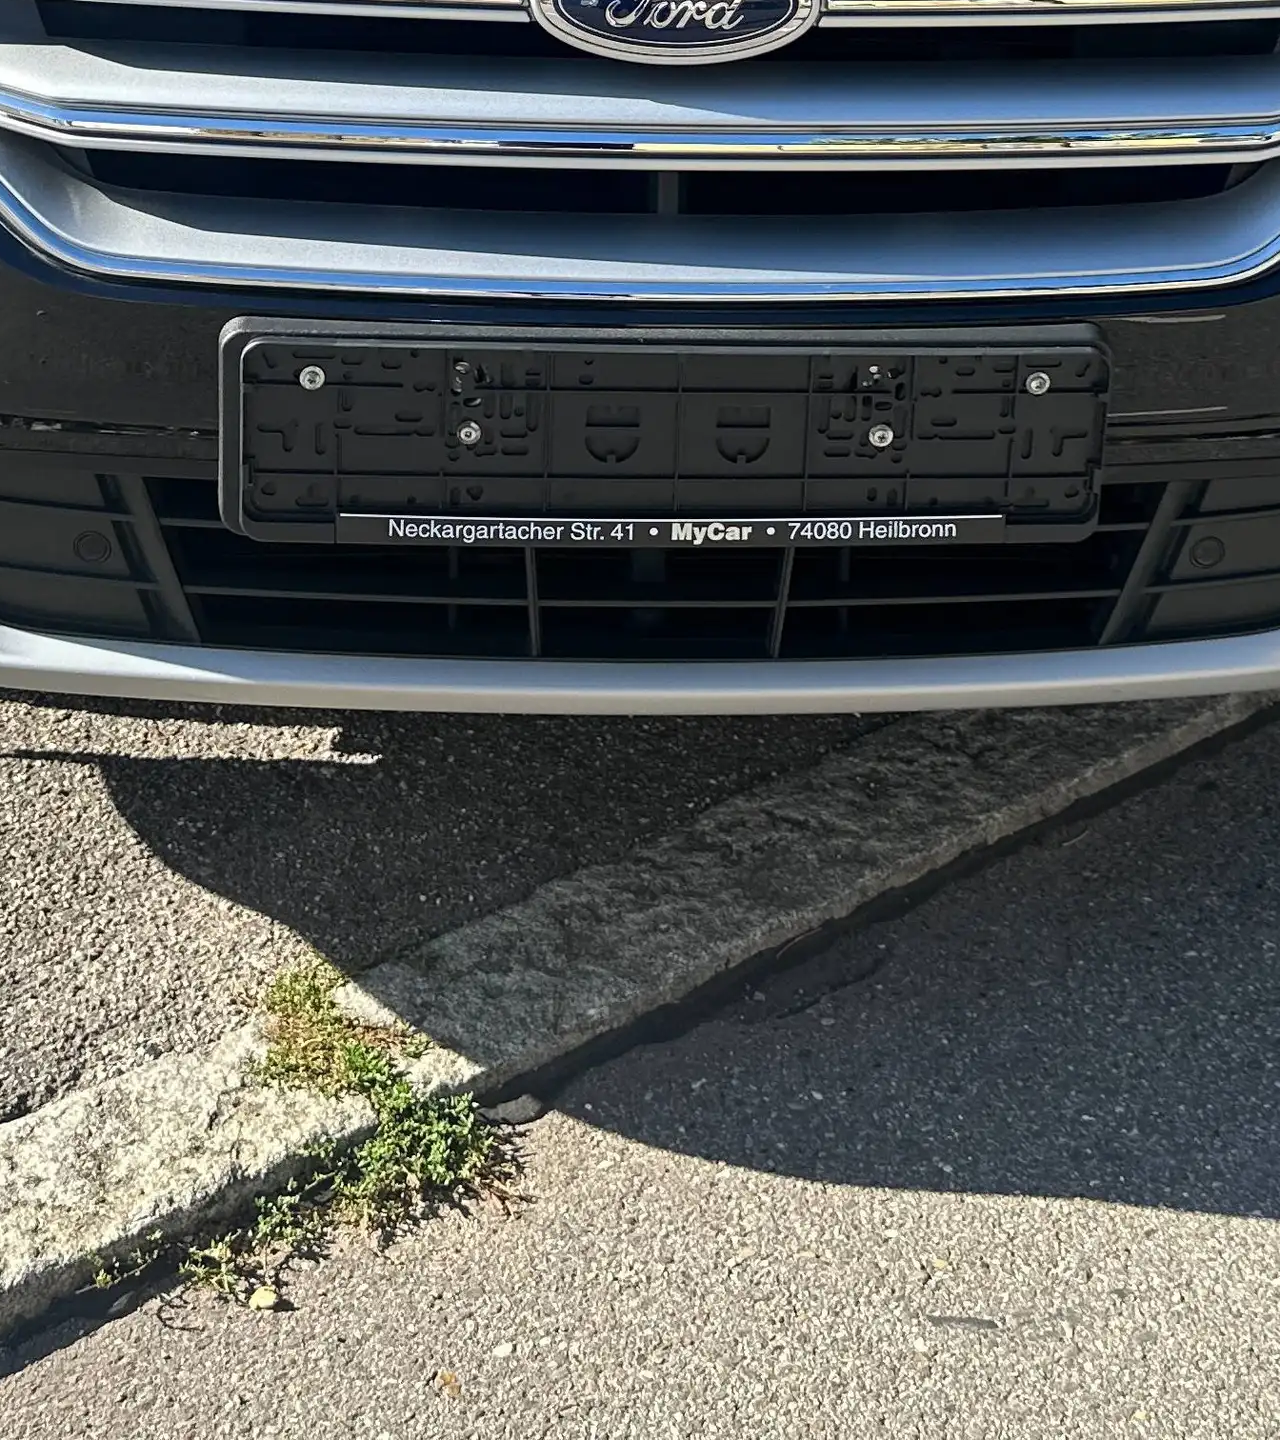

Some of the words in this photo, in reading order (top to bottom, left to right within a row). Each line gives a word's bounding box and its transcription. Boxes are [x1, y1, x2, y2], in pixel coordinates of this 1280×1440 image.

[388, 518, 564, 544] Neckargartacher
[570, 522, 605, 541] Str.
[610, 523, 634, 541] 41
[671, 522, 753, 545] MyCar
[788, 521, 852, 540] 74080
[858, 520, 957, 539] Heilbronn
